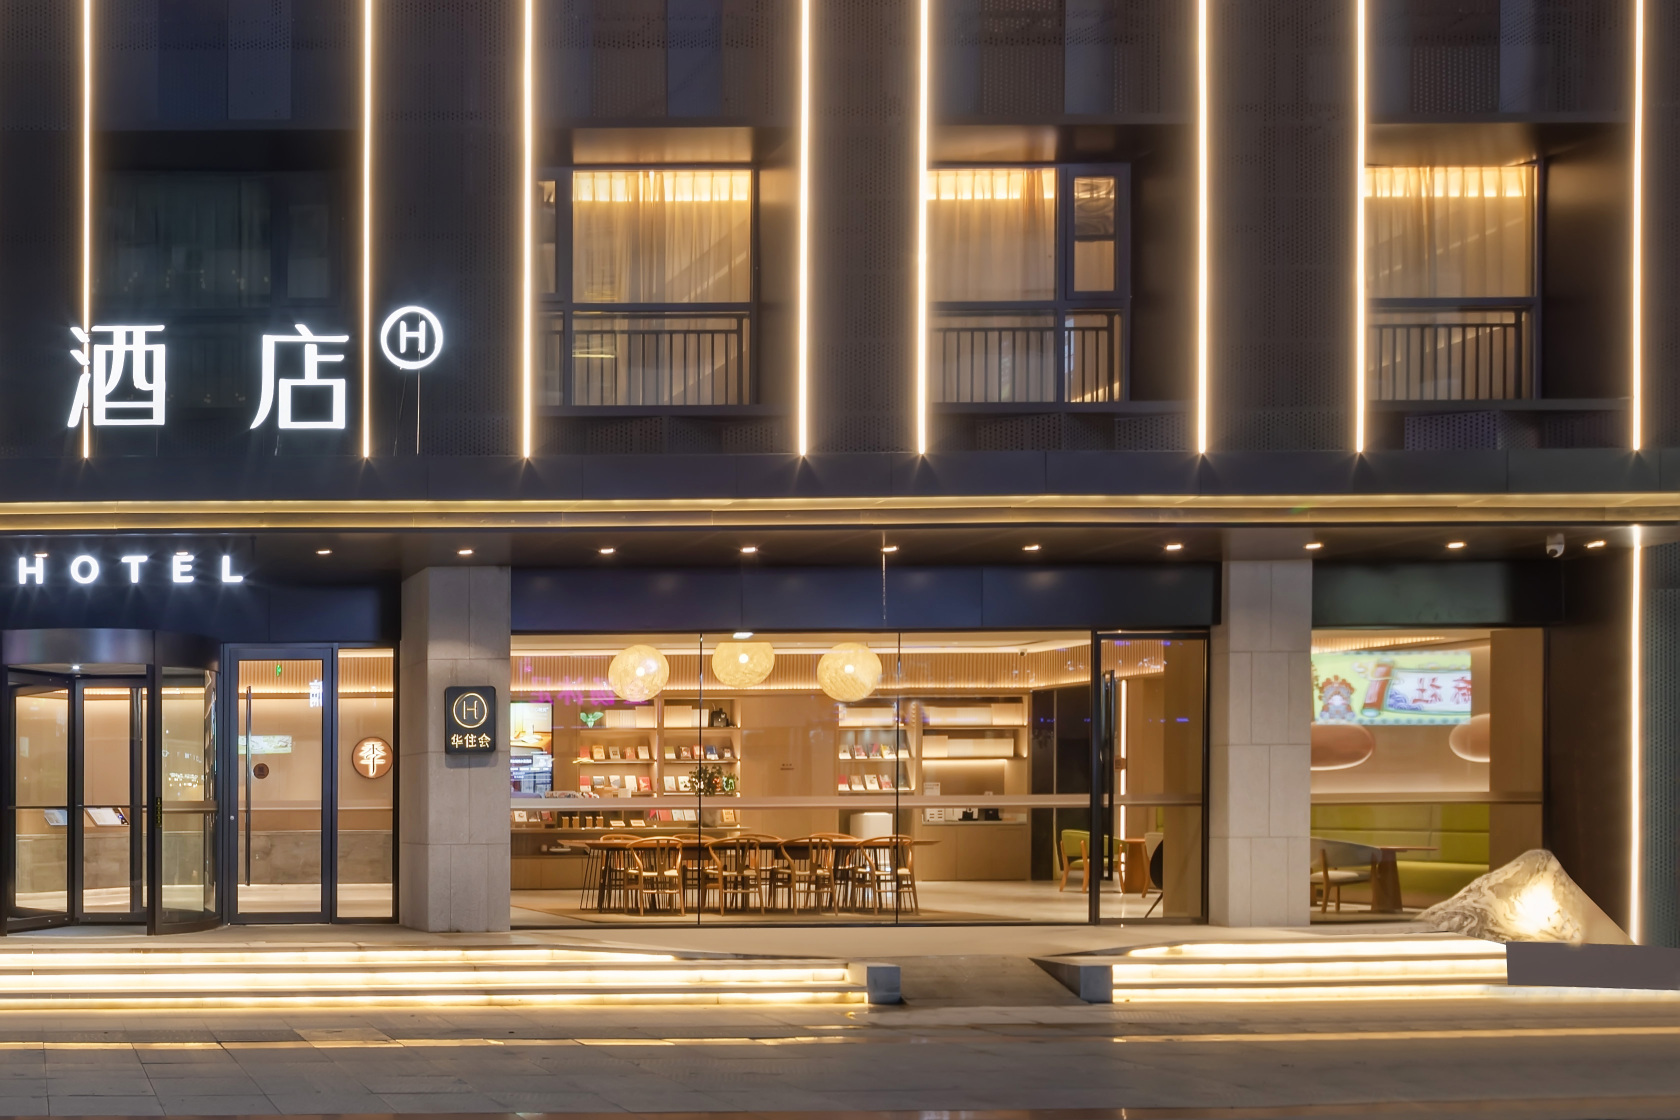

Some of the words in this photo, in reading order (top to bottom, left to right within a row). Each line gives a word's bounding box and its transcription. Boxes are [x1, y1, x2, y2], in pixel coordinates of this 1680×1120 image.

[18, 554, 244, 585] HOTEL
[450, 733, 492, 749] 华住会
